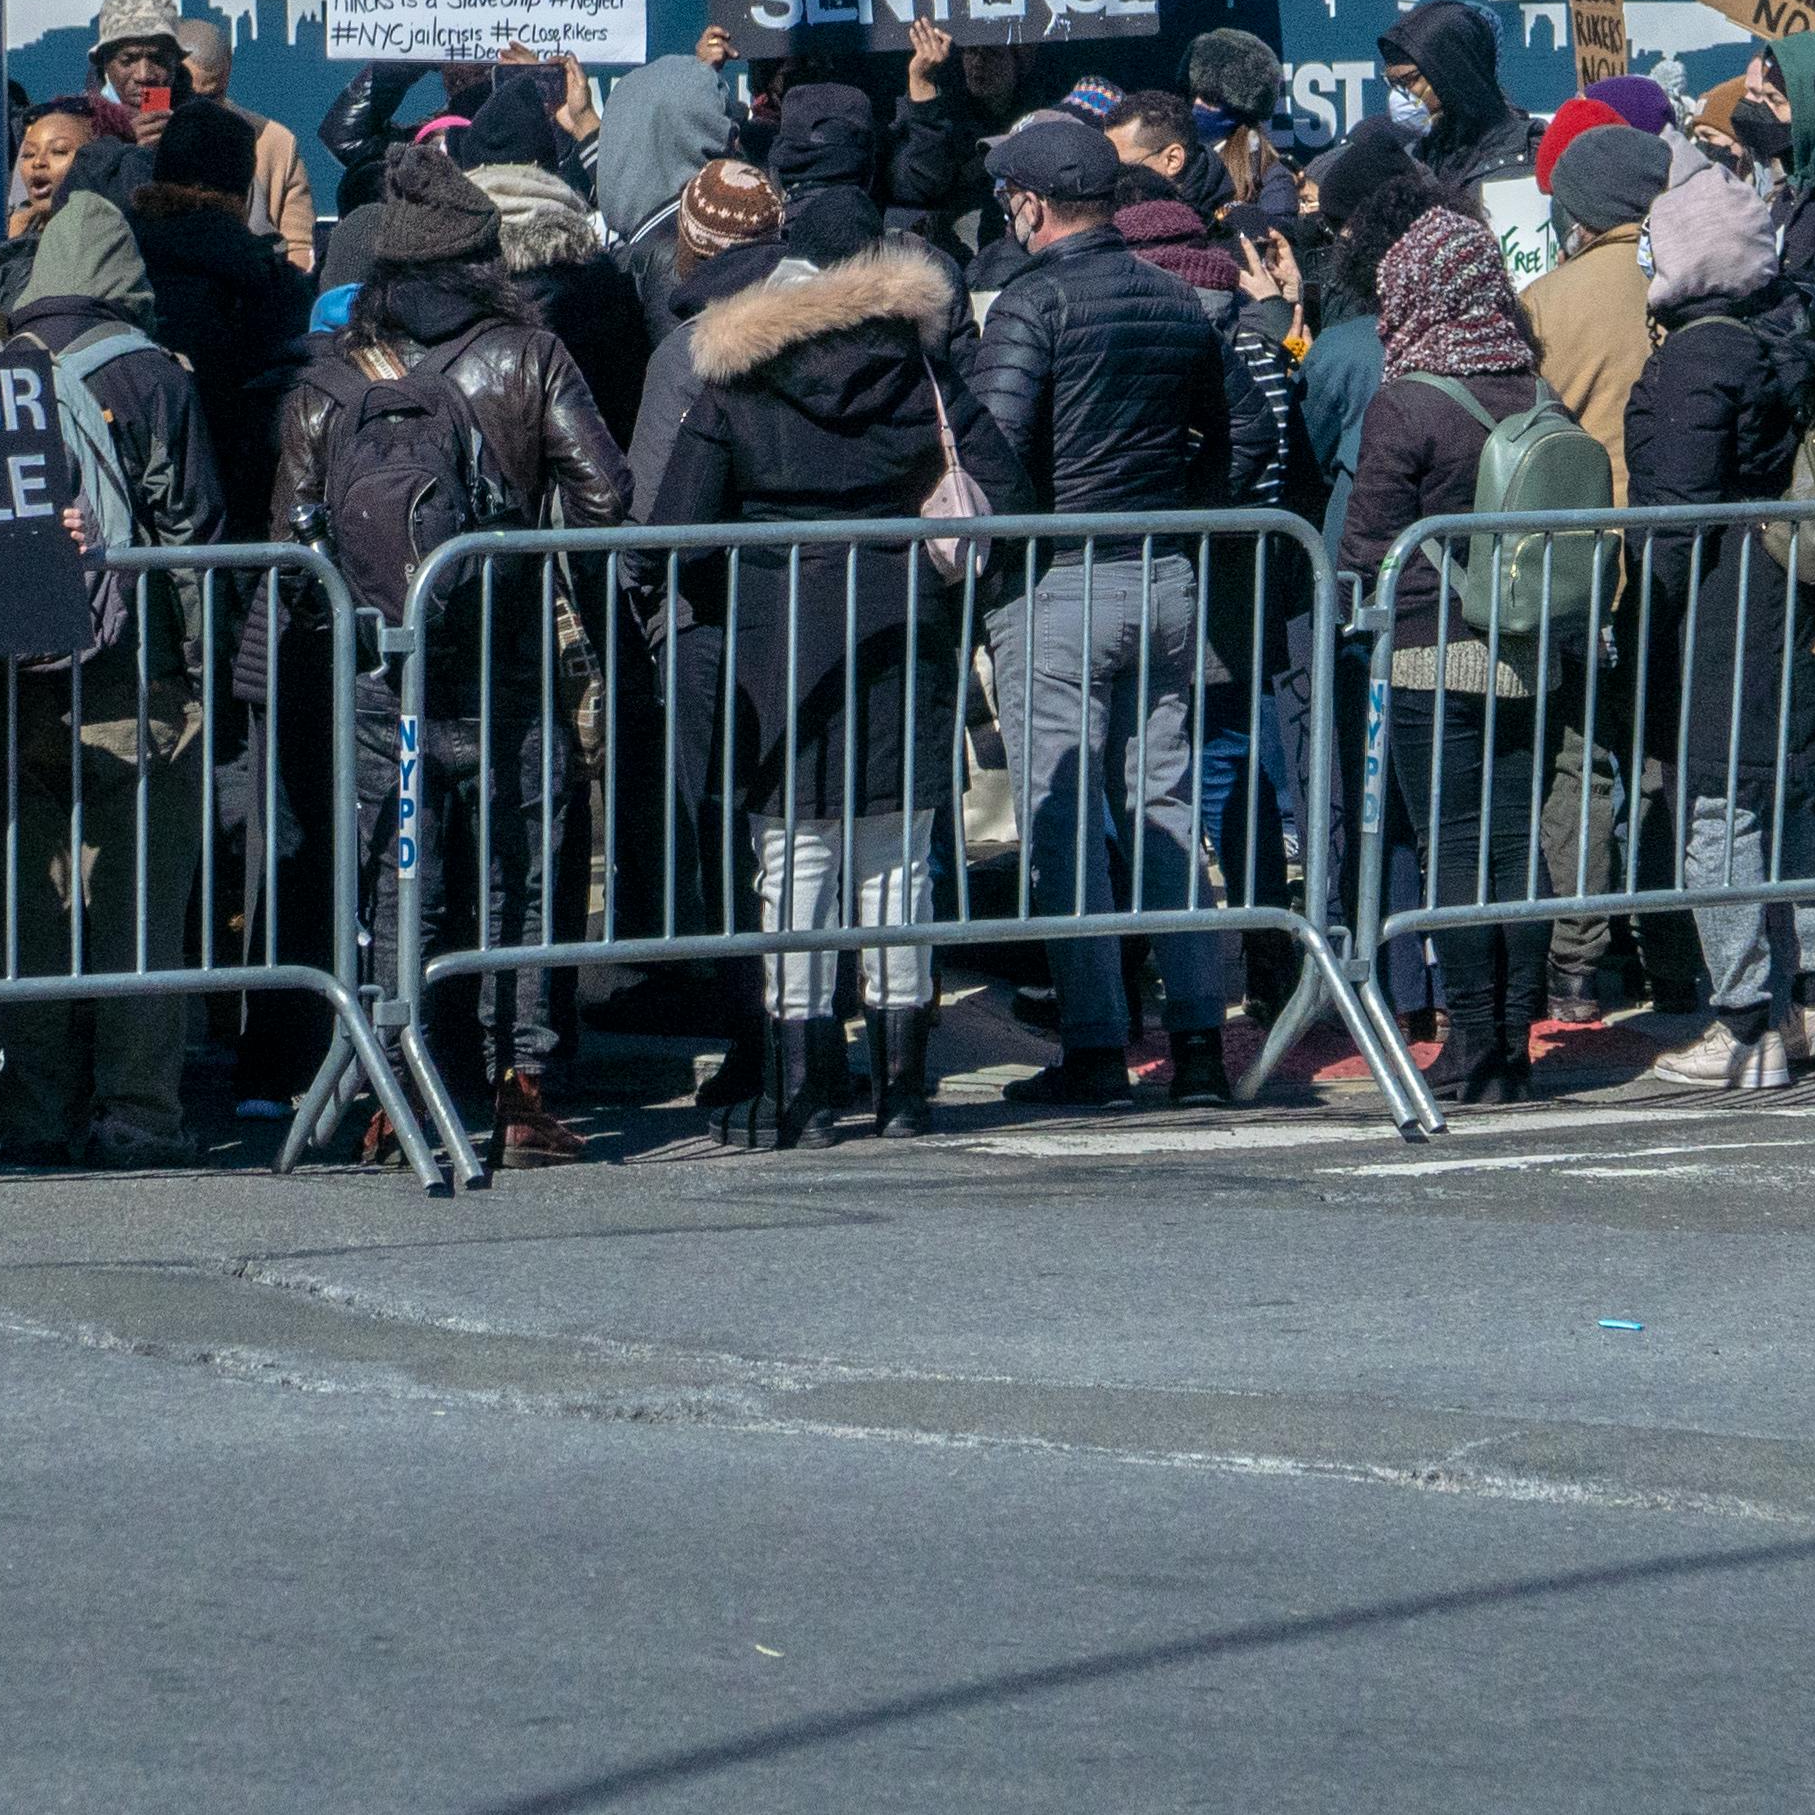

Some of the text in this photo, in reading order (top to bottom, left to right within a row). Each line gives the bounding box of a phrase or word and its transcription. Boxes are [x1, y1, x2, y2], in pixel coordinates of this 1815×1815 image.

[332, 17, 483, 53] #NYCjailcrisis
[1574, 13, 1623, 57] RIKERS
[1501, 226, 1544, 273] FREE
[1363, 682, 1385, 824] NYPD
[398, 720, 417, 870] NYPD
